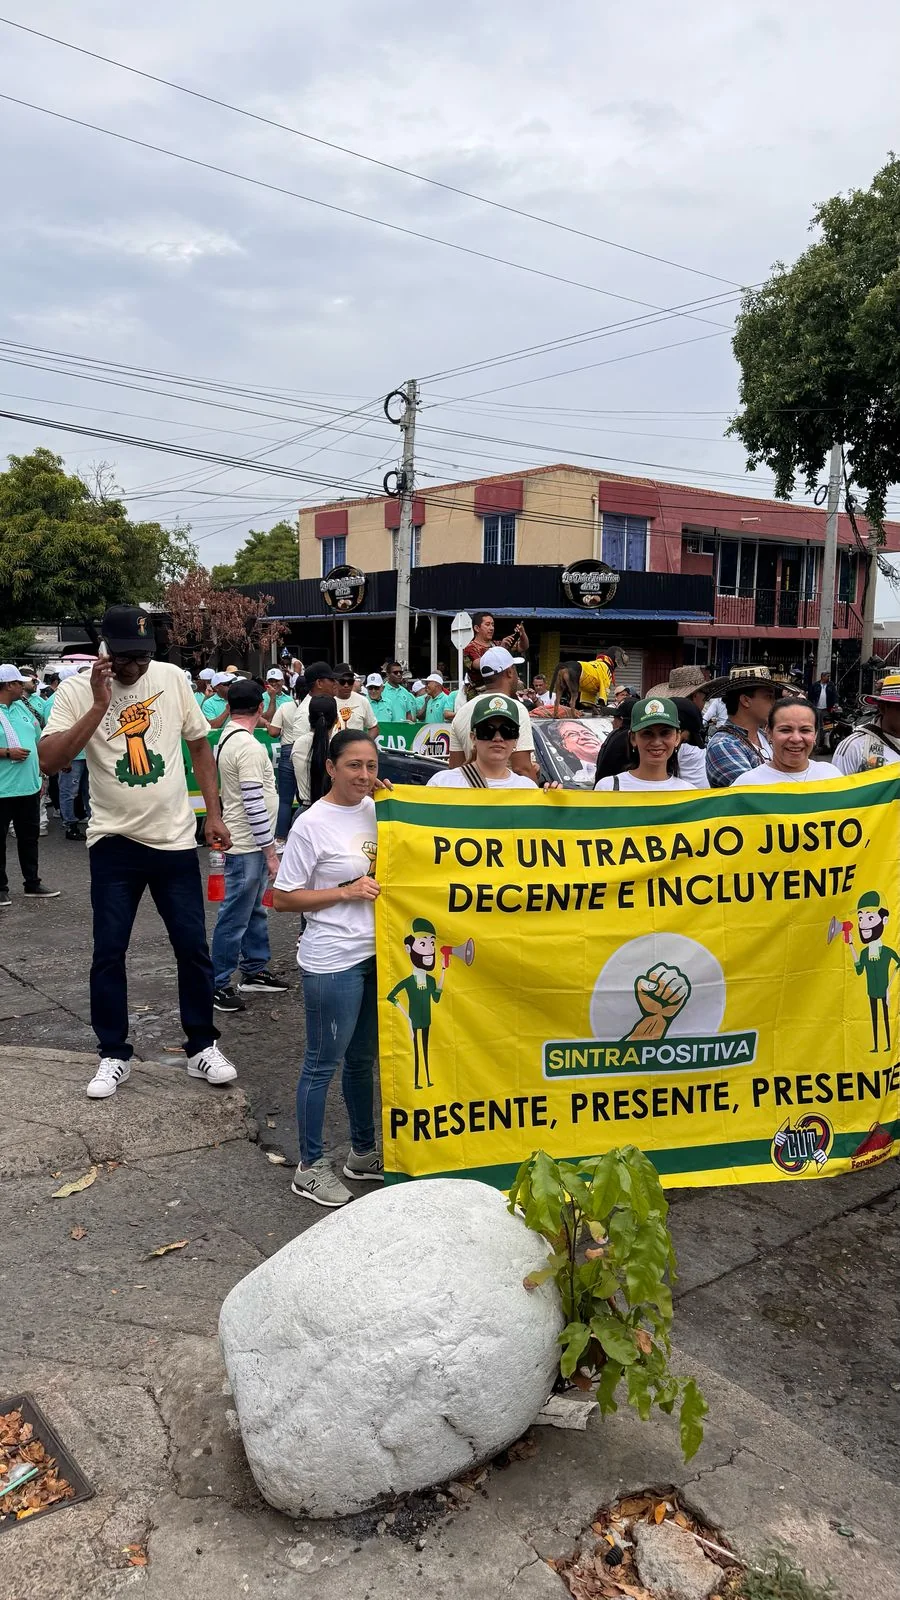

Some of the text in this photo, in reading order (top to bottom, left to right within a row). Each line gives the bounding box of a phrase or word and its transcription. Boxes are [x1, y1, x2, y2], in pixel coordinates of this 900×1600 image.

[433, 818, 870, 867] POR UN TRABAJO JUSTO,
[448, 864, 857, 913] DECENTE E INCLUYENTE
[549, 1040, 750, 1070] SINTRAPOSITIVA
[390, 1062, 900, 1141] PRESENTE, PRESENTE, PRESENTE
[786, 1128, 817, 1158] CUT
